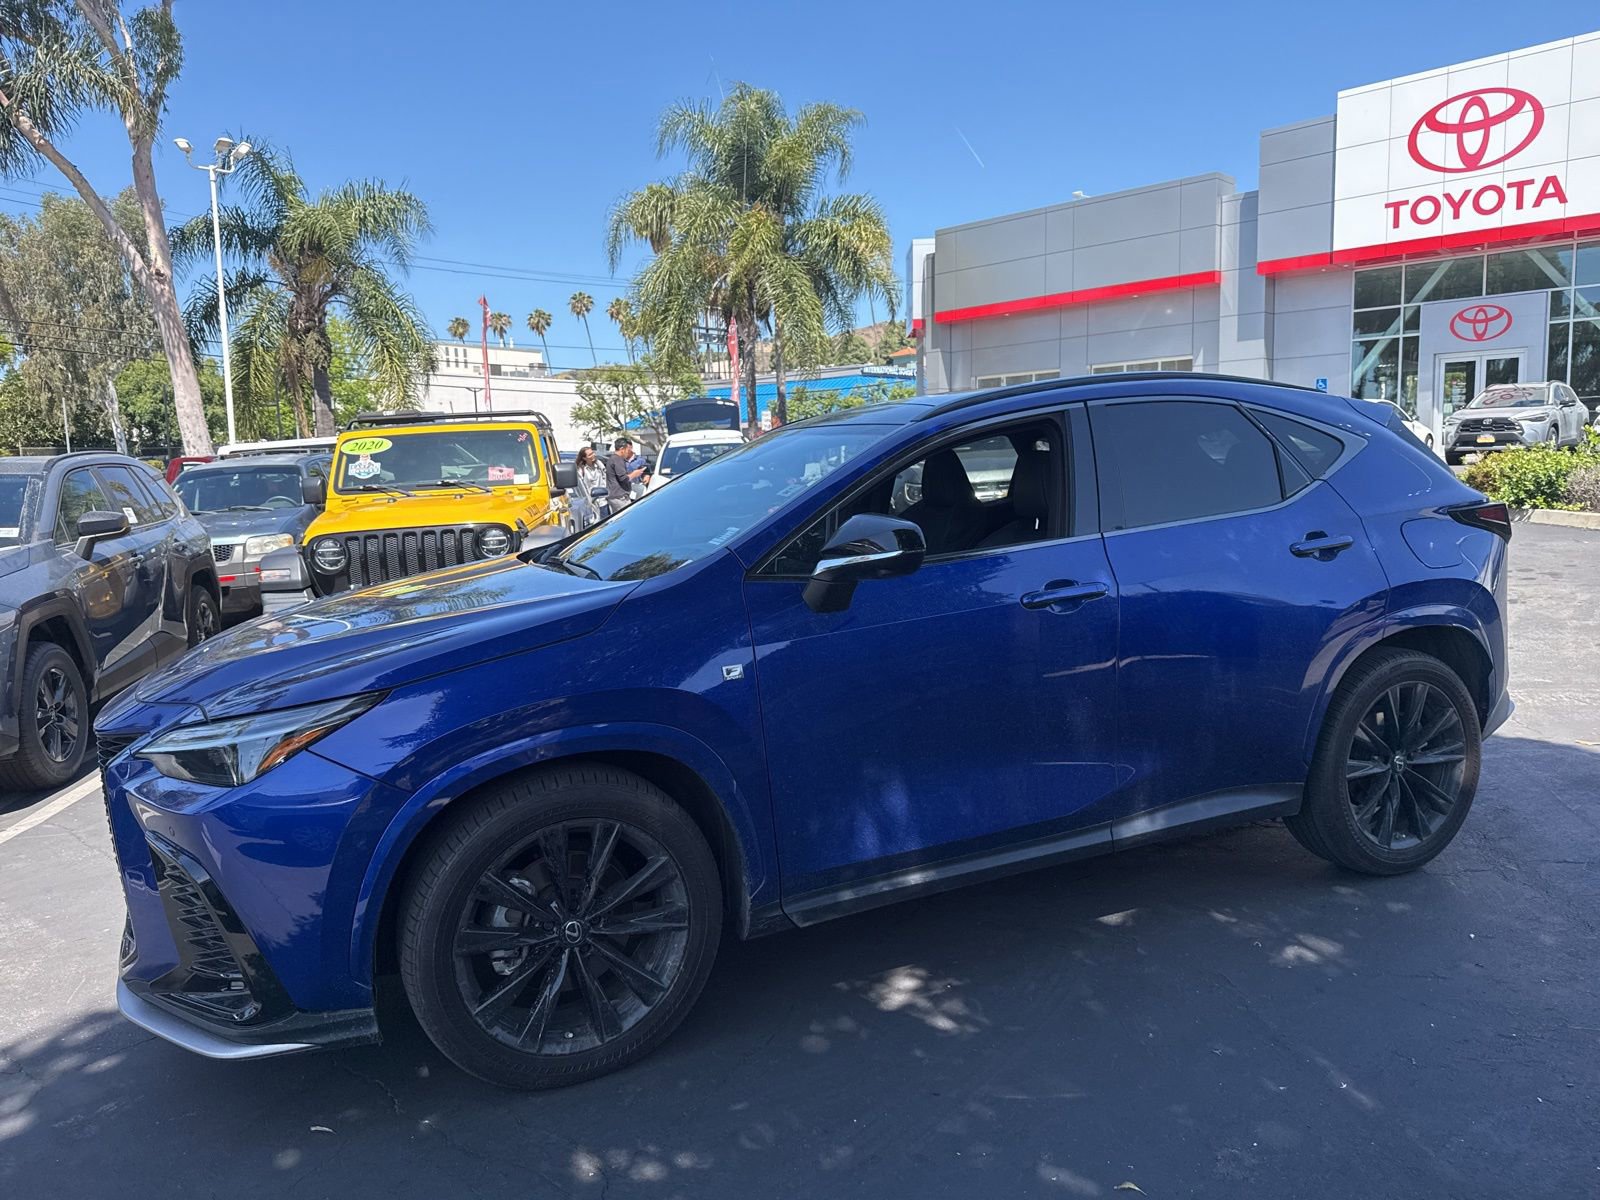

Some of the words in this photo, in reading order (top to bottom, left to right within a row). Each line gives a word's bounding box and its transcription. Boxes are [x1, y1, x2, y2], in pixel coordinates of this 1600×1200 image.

[1385, 175, 1568, 229] TOYOTA
[864, 366, 899, 375] INTERNATIONAL
[349, 441, 384, 452] 2020
